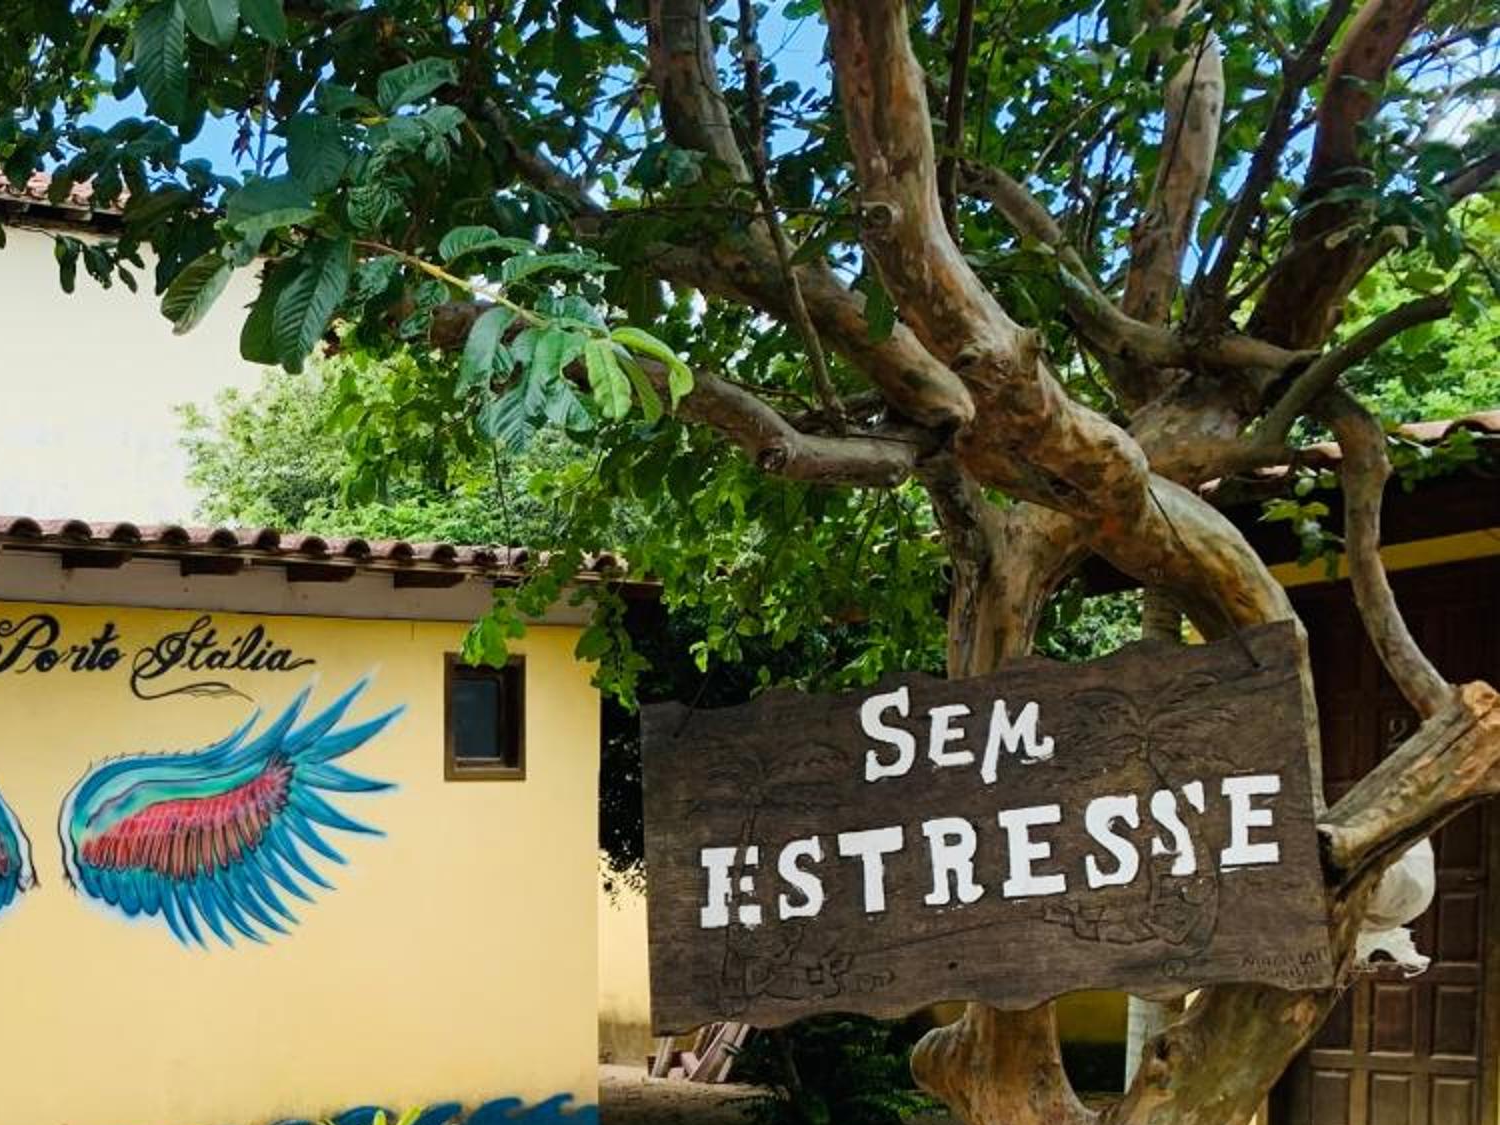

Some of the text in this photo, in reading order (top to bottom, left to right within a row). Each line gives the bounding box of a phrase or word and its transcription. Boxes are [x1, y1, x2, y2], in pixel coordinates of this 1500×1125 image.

[130, 615, 316, 701] Itália
[859, 685, 1055, 784] SEM
[700, 773, 1282, 930] ESTRESSE
